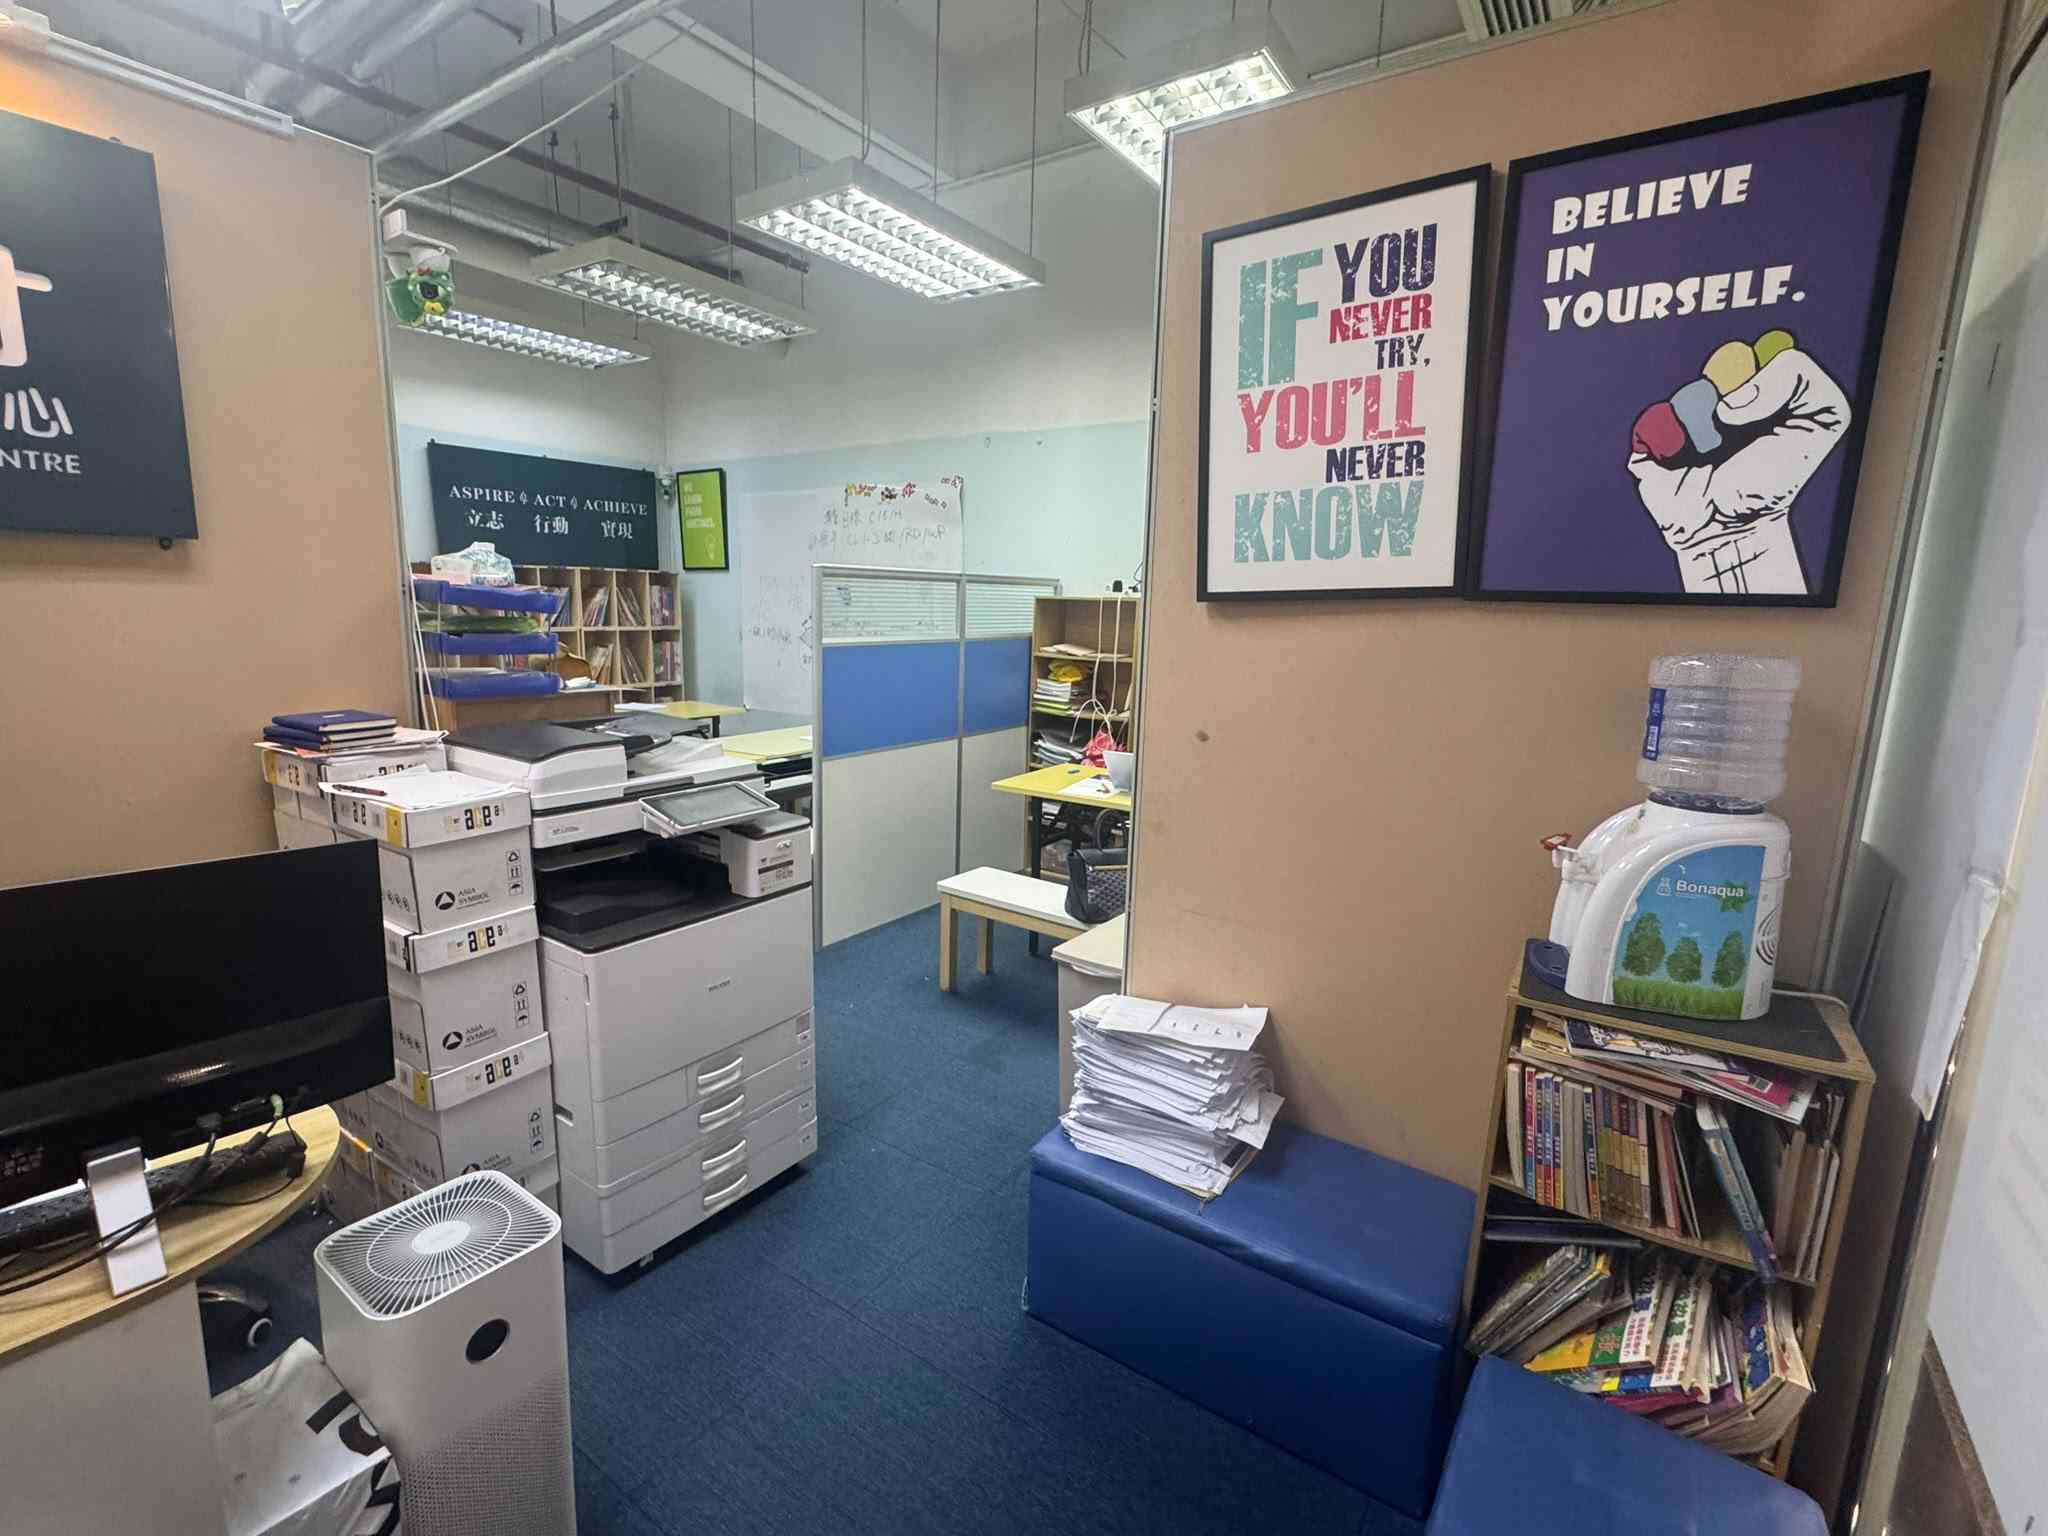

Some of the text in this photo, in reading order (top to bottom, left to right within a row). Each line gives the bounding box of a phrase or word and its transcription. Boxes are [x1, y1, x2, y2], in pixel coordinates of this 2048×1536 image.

[1552, 163, 1752, 235] BELIEVE
[1546, 243, 1595, 284] IN
[1238, 223, 1438, 389] IF YOU
[1329, 293, 1433, 344] NEVER
[1543, 264, 1806, 331] YOURSELF.
[1375, 333, 1431, 370] TRY,
[1237, 370, 1426, 453] YOU'LL
[1325, 440, 1426, 483] NEVER
[449, 485, 649, 515] ASPIRE ACT ACHIEVE
[466, 509, 504, 530] 立志
[534, 514, 569, 535] 行動
[1233, 480, 1425, 563] KNOW
[1676, 880, 1744, 898] Bonaqua
